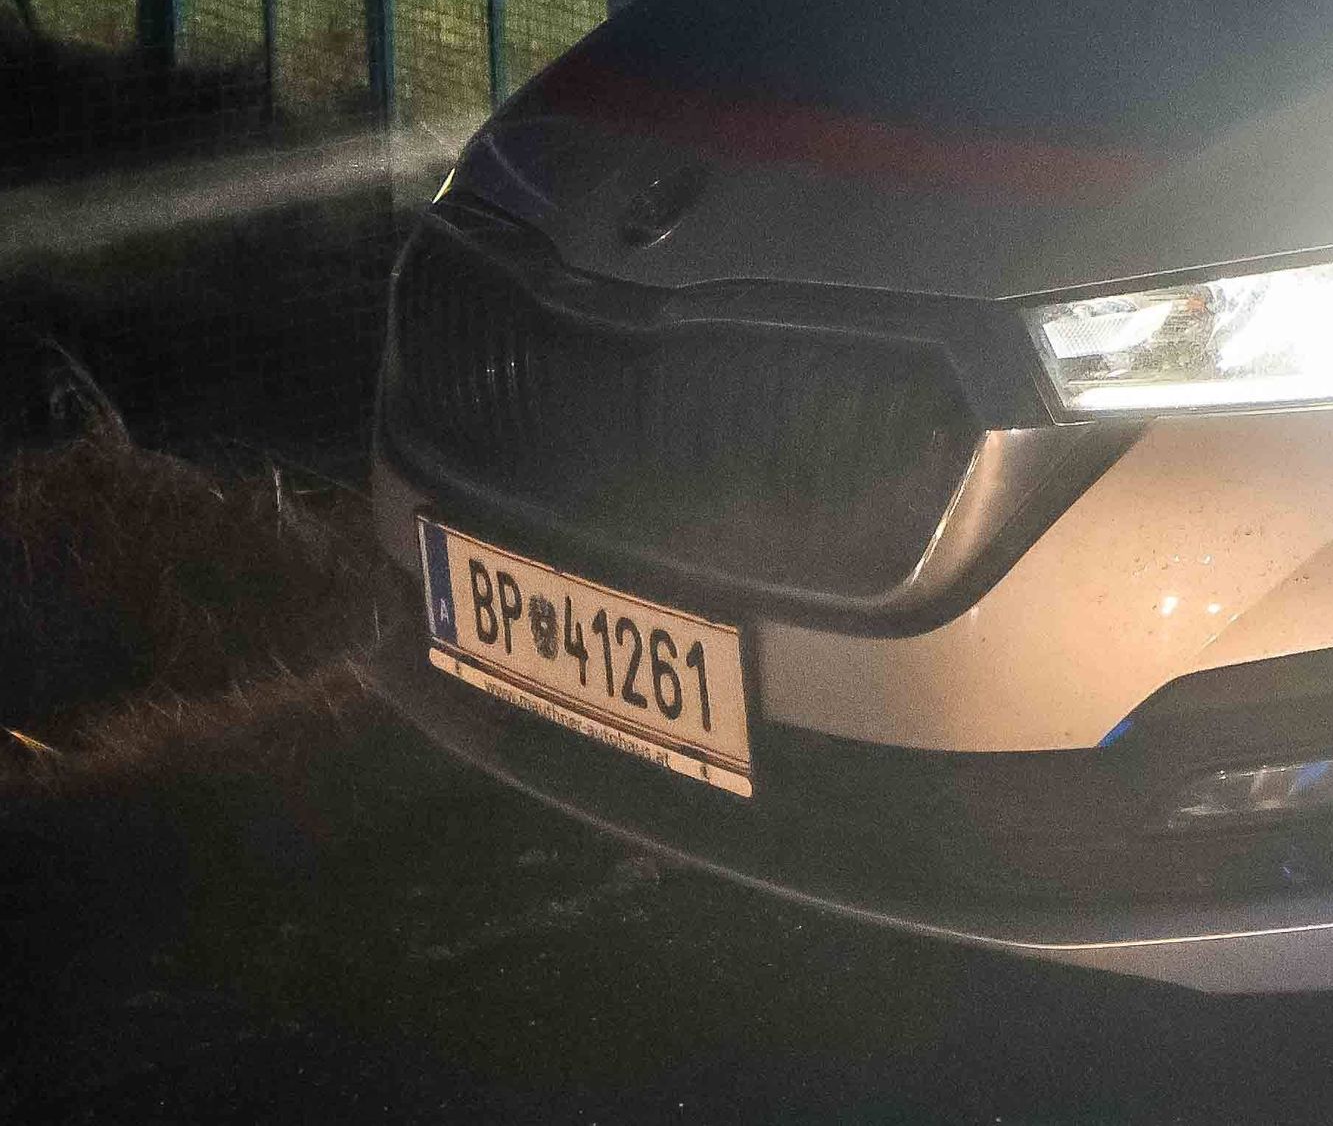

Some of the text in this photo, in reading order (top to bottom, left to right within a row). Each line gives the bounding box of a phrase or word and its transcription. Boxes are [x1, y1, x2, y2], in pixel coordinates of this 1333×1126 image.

[440, 598, 450, 622] A
[468, 557, 523, 655] BP
[563, 595, 712, 733] 41261
